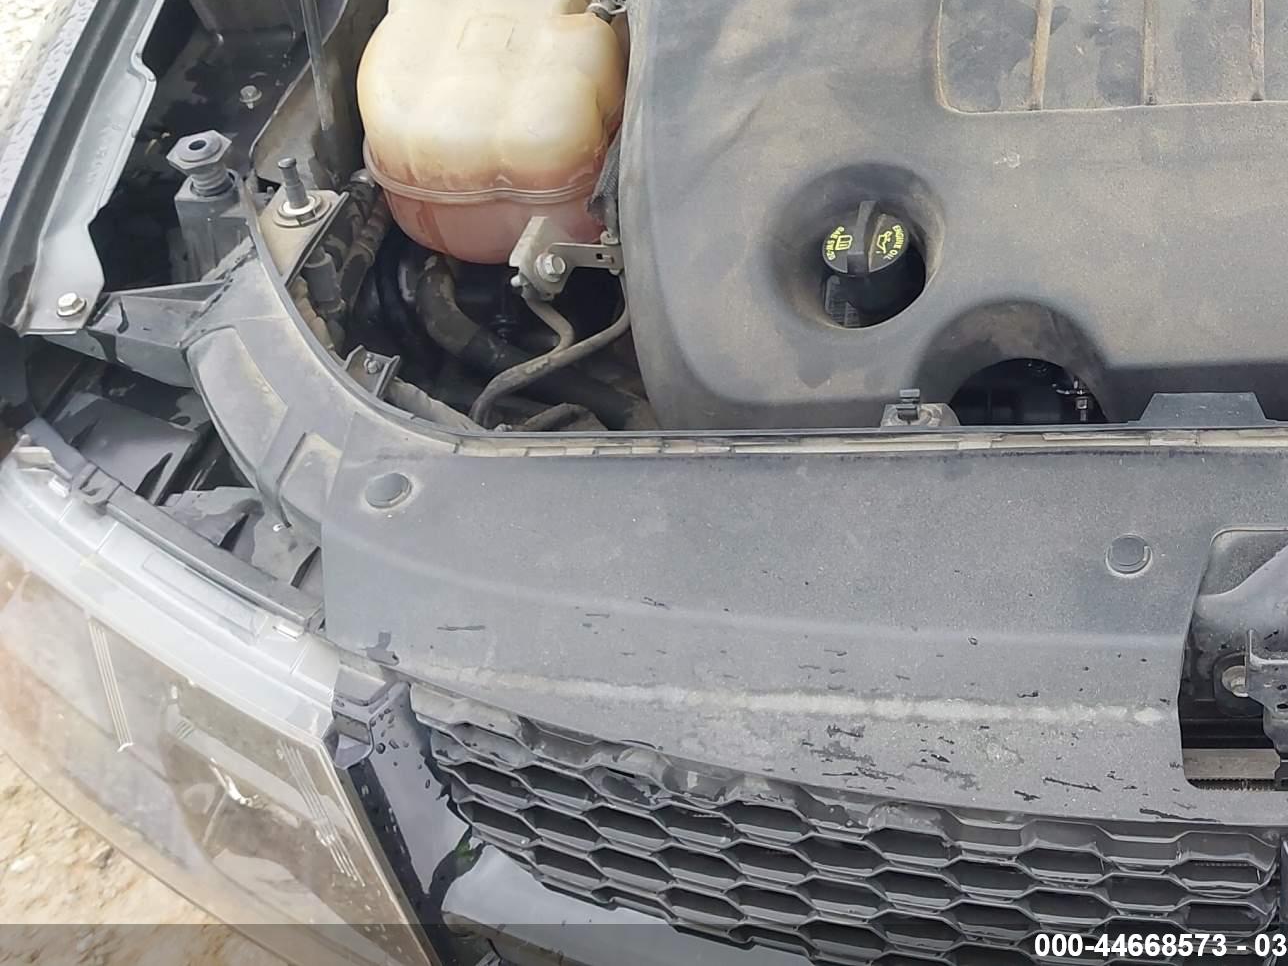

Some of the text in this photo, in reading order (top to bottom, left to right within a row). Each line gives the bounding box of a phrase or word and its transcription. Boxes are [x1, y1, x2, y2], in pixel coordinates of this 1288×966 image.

[830, 226, 844, 239] SAE
[883, 225, 904, 260] ENGINE OIL
